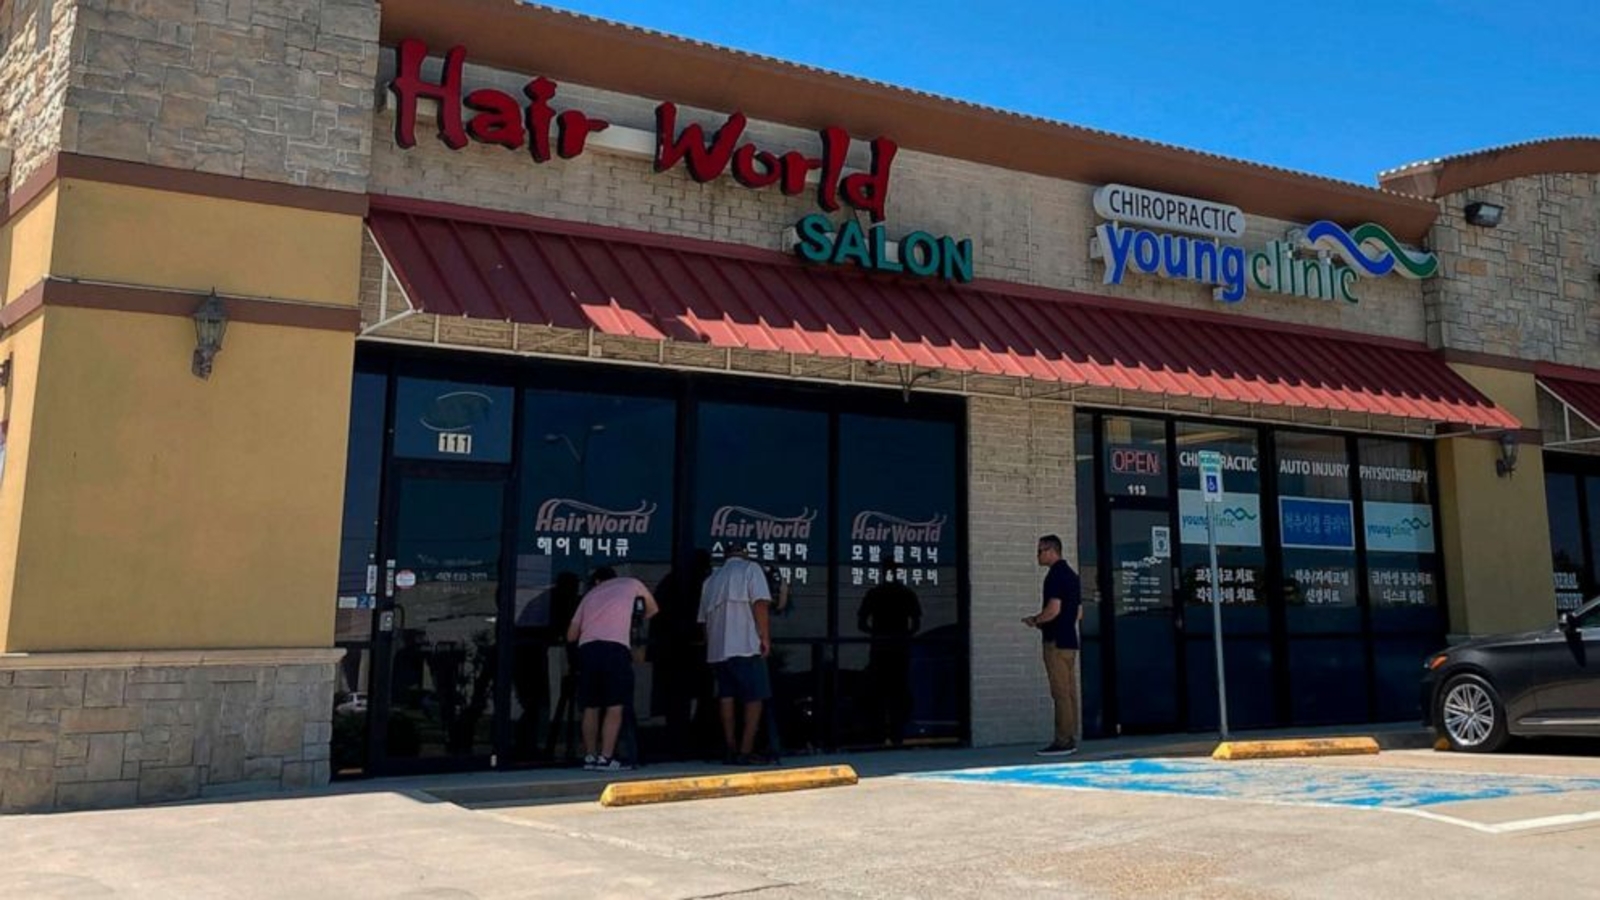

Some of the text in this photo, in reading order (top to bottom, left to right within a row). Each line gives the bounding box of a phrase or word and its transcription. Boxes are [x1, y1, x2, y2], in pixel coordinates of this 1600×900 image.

[390, 38, 897, 222] Hair World
[1109, 188, 1238, 235] CHIROPRACTIC
[795, 213, 973, 284] SALON
[440, 434, 470, 453] 111
[1112, 451, 1160, 474] OPEN
[1179, 452, 1258, 472] CHIRACTIC
[1279, 460, 1350, 477] AUTO INJURY
[1359, 465, 1428, 483] PHYSIOTHERAPY
[1127, 485, 1147, 496] 113
[536, 536, 630, 557] 헤어 매니큐
[711, 541, 808, 561] 스드열파마
